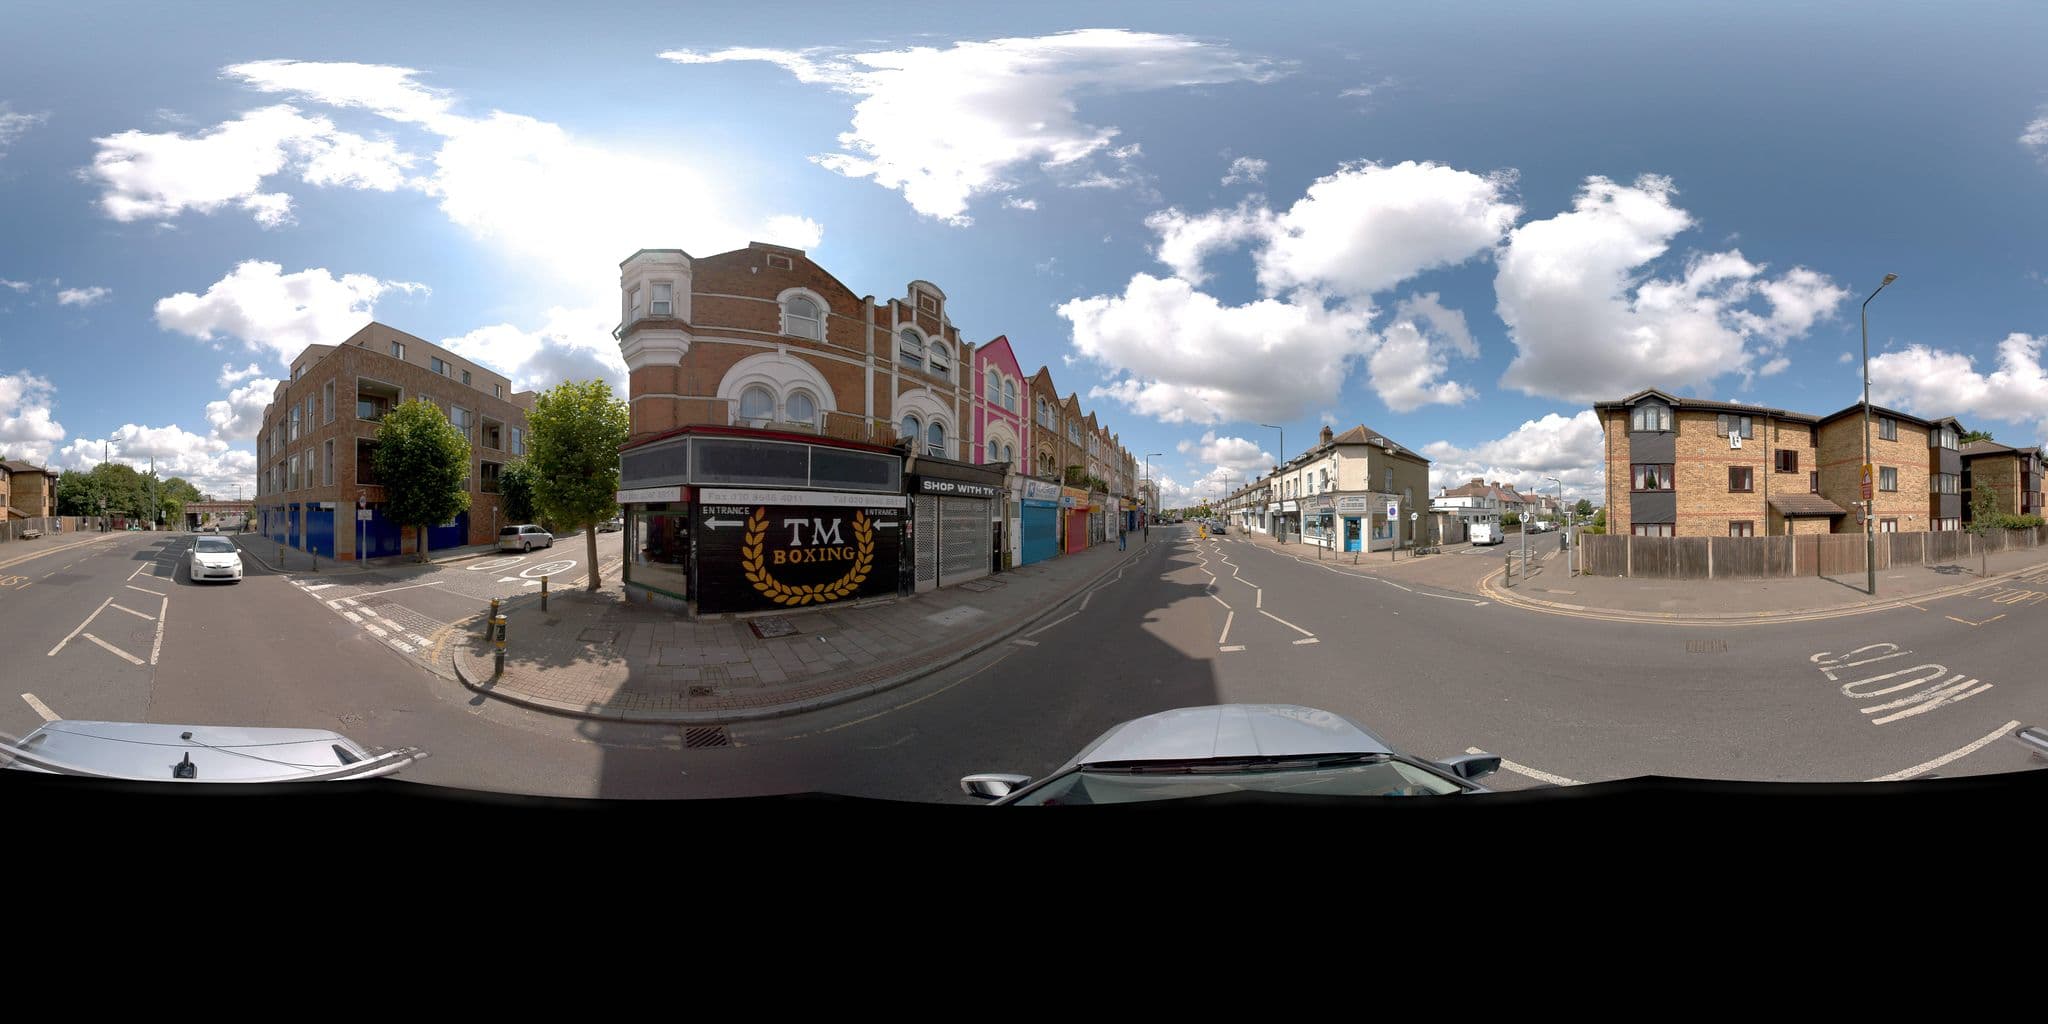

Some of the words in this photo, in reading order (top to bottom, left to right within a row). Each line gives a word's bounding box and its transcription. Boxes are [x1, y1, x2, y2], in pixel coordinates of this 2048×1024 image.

[923, 481, 954, 491] SHOP
[957, 484, 982, 494] WITH
[983, 487, 994, 495] TK
[703, 506, 751, 515] ENTRANCE
[864, 508, 898, 516] ENTRANCE
[783, 518, 844, 546] TM
[773, 547, 856, 564] BOXING
[1810, 643, 1994, 726] SLOW
